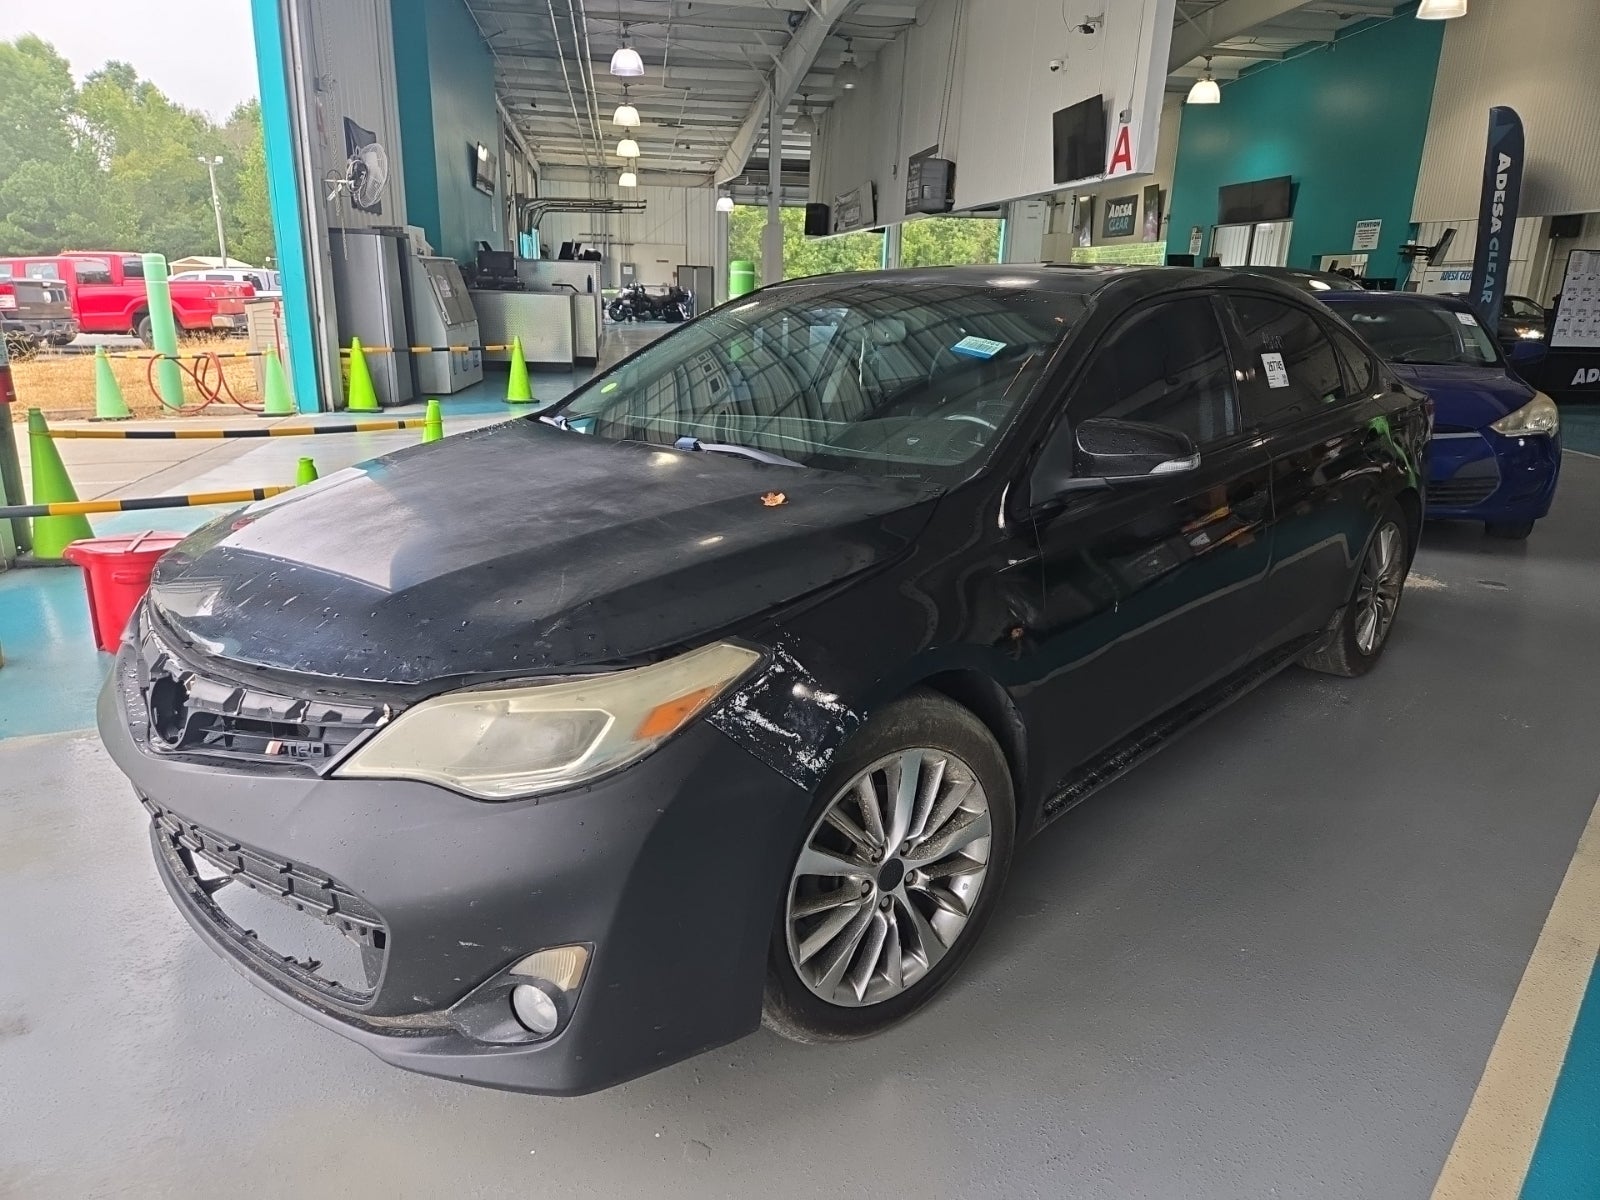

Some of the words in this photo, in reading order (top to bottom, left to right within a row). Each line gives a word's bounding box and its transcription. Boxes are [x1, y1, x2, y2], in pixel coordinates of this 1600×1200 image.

[1109, 126, 1132, 174] A
[1490, 152, 1512, 234] ADESA
[1108, 203, 1133, 218] ADESA
[1108, 217, 1129, 231] CLEAR
[1440, 271, 1459, 281] ADESA
[1480, 237, 1499, 303] CLEAR
[1570, 367, 1600, 386] AD
